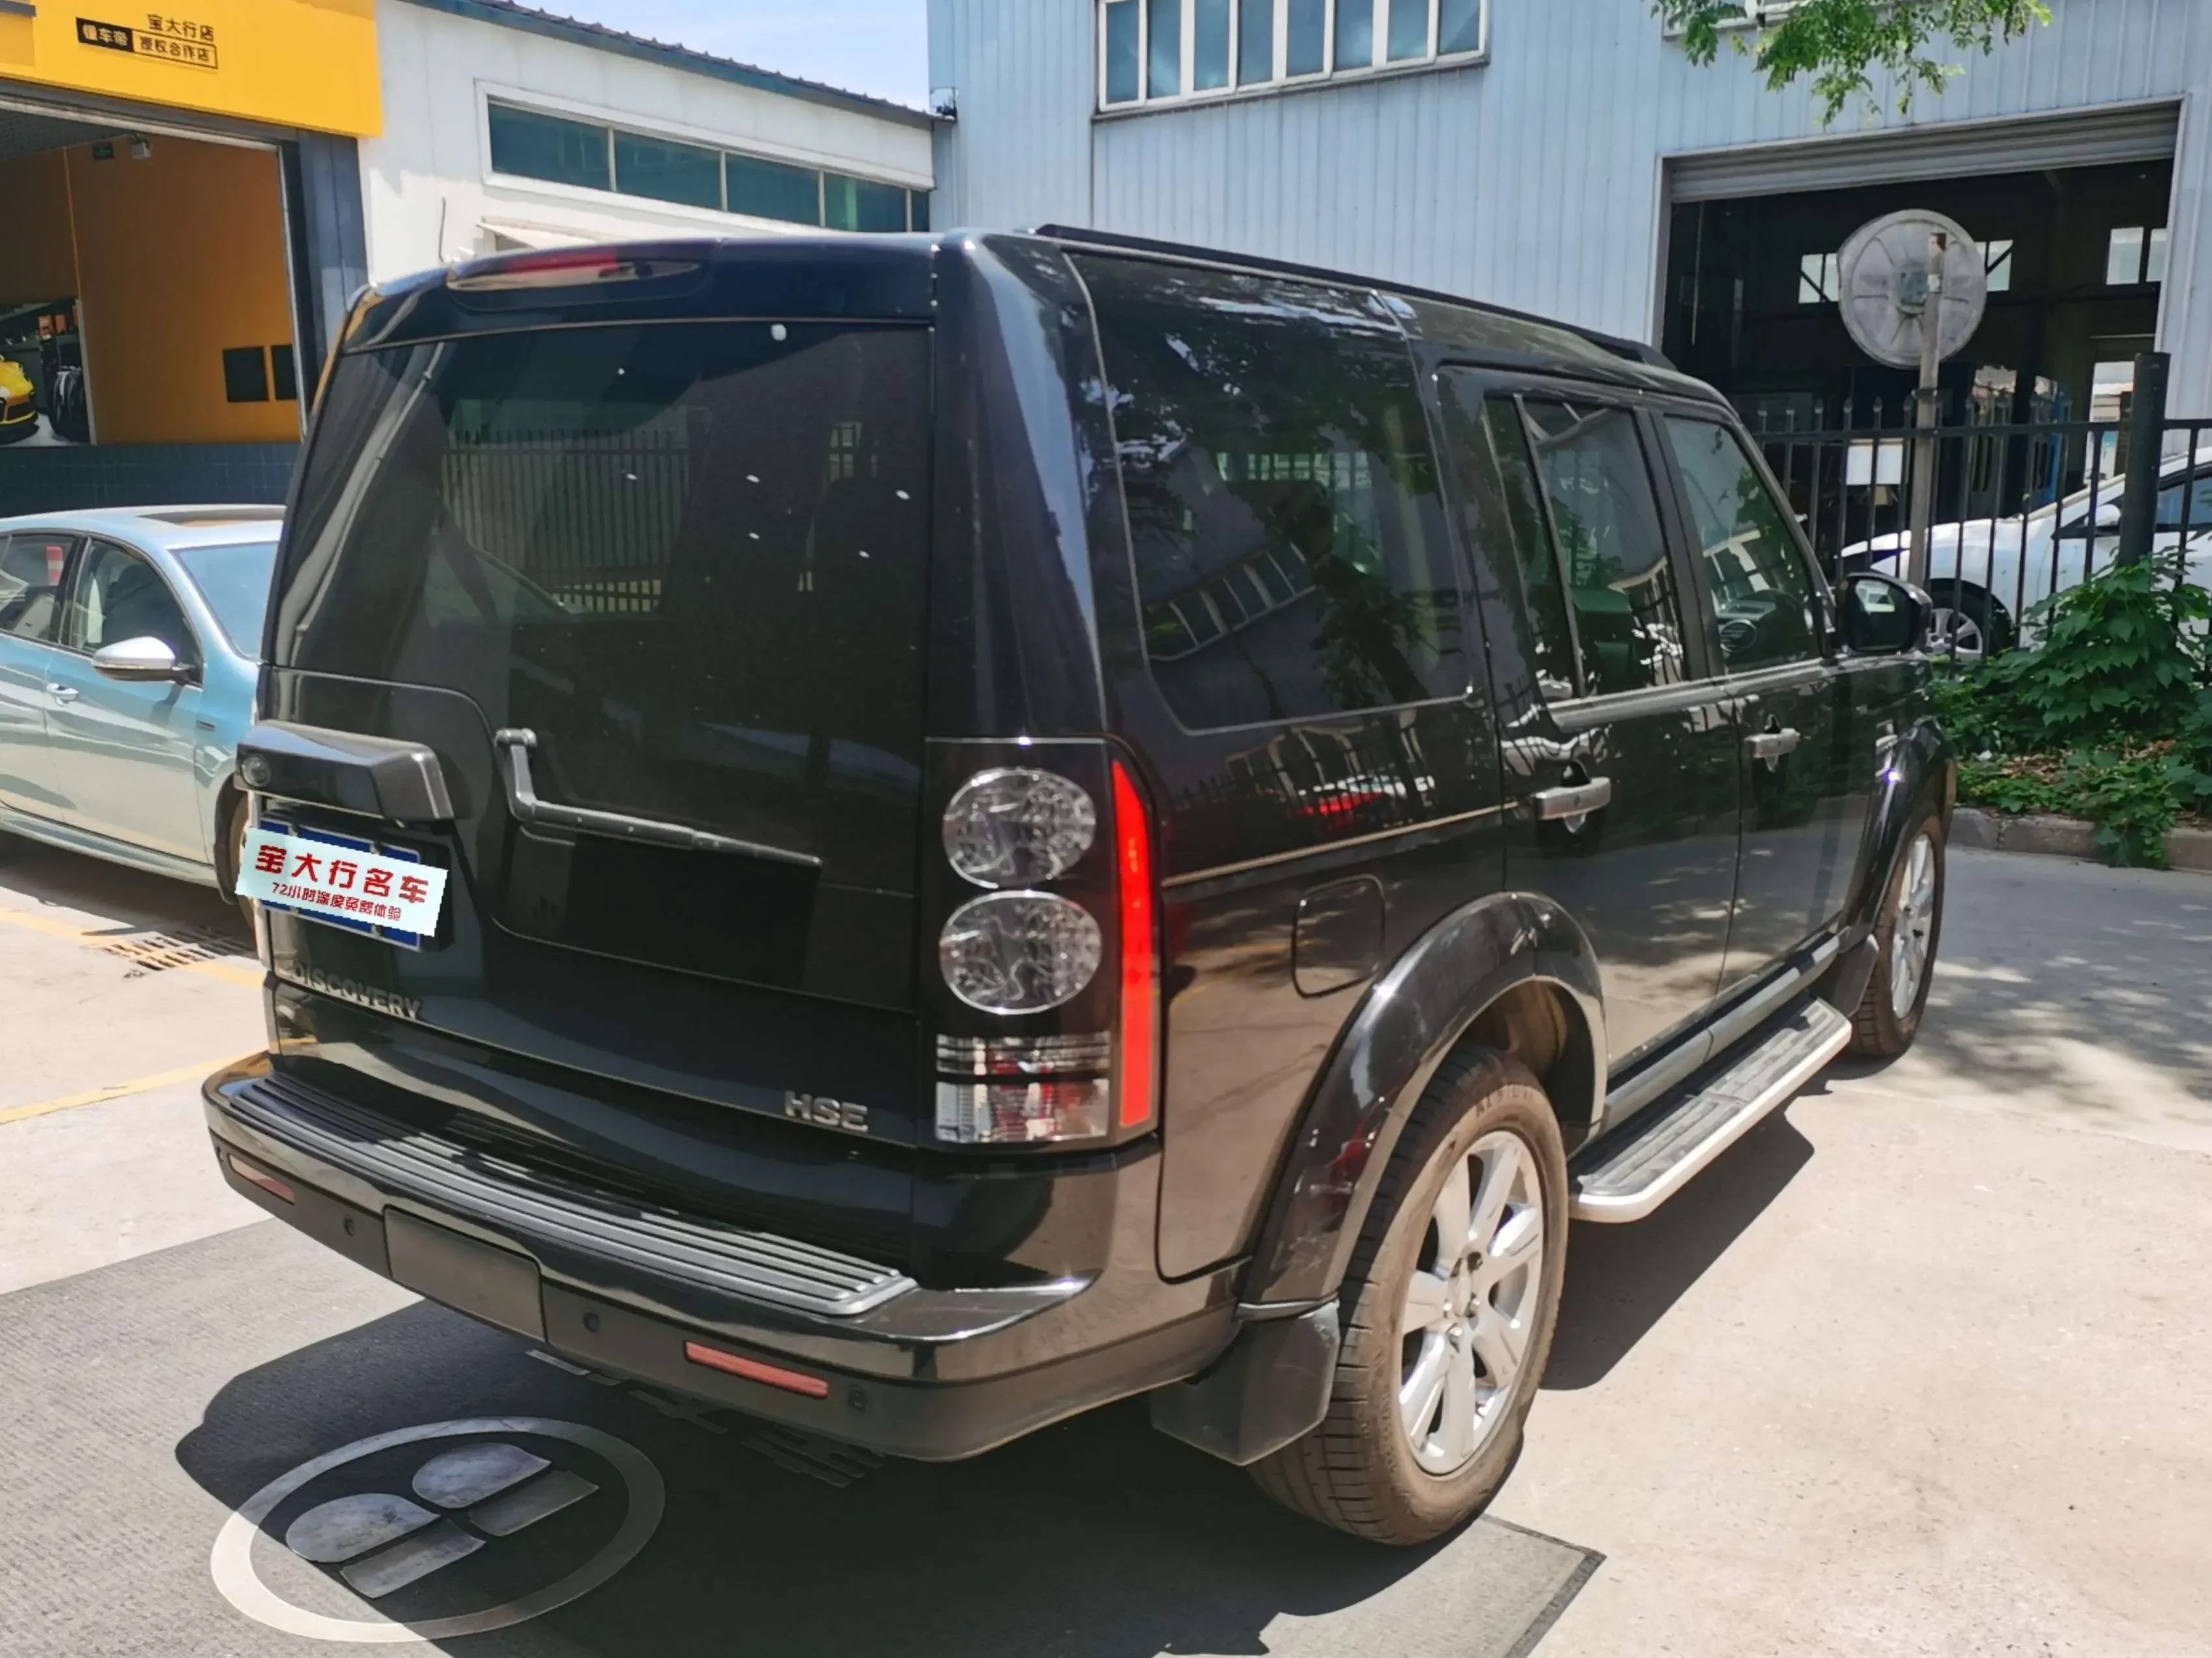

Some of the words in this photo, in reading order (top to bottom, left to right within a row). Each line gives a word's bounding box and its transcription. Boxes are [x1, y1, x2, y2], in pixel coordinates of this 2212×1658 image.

[147, 14, 214, 42] 宝大行店
[292, 962, 422, 1020] DISCOVERY
[785, 1089, 869, 1132] HSE
